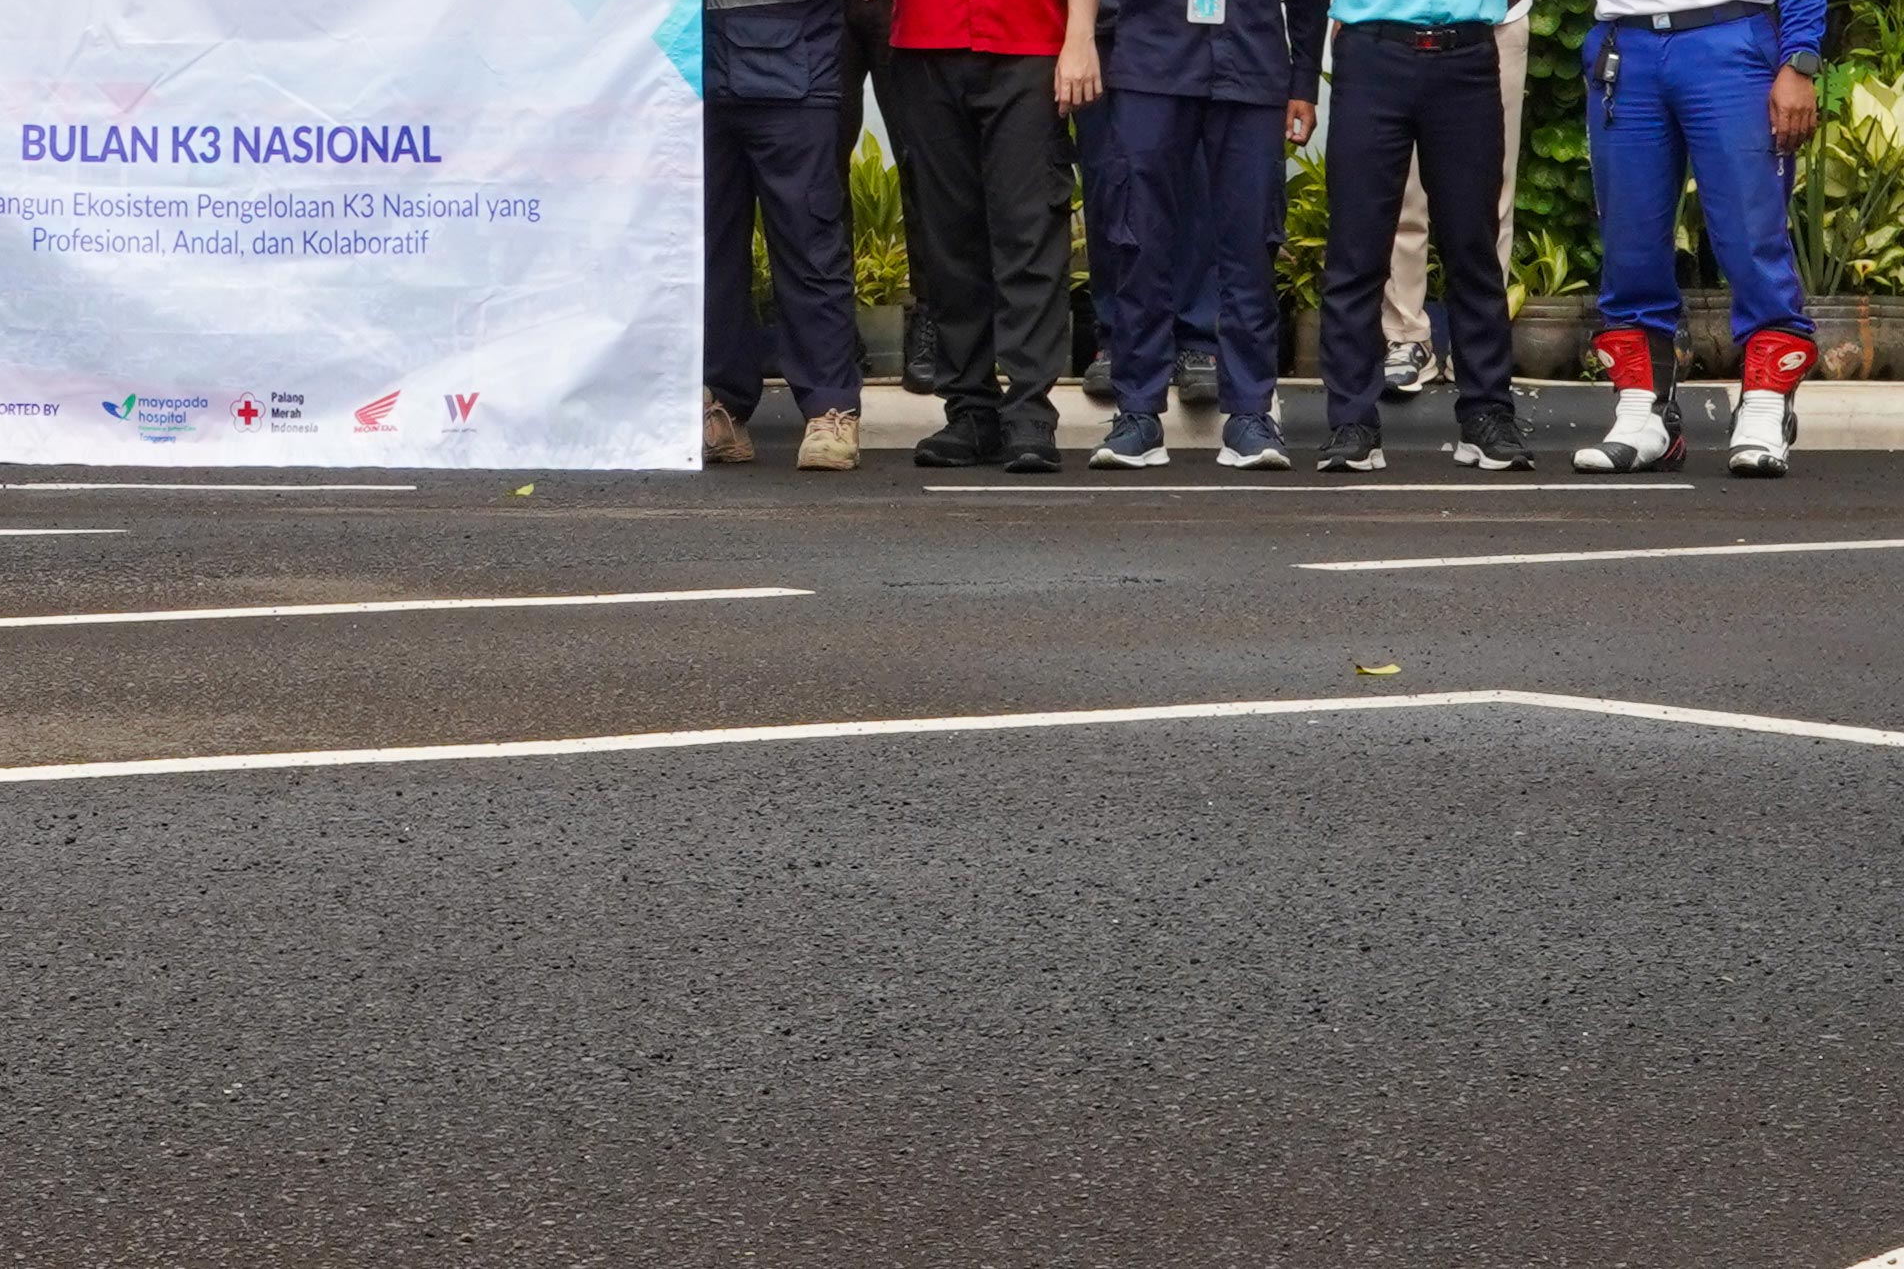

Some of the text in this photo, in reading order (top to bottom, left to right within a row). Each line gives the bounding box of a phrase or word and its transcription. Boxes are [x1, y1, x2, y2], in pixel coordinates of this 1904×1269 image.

[22, 124, 442, 164] BULAN K3 NASIONAL
[73, 192, 189, 218] Ekosistem
[198, 194, 335, 224] Pengelolaan
[343, 194, 374, 218] K3
[383, 193, 479, 218] Nasional
[486, 197, 541, 223] yang
[33, 227, 430, 257] Profesional, Andal, dan Kolaboratif
[138, 396, 208, 411] mayapada
[271, 392, 304, 405] Palang
[43, 403, 60, 416] BY
[271, 408, 302, 419] Merah
[138, 410, 187, 426] hospital
[271, 422, 319, 434] Indonesia
[353, 425, 398, 433] HONDA
